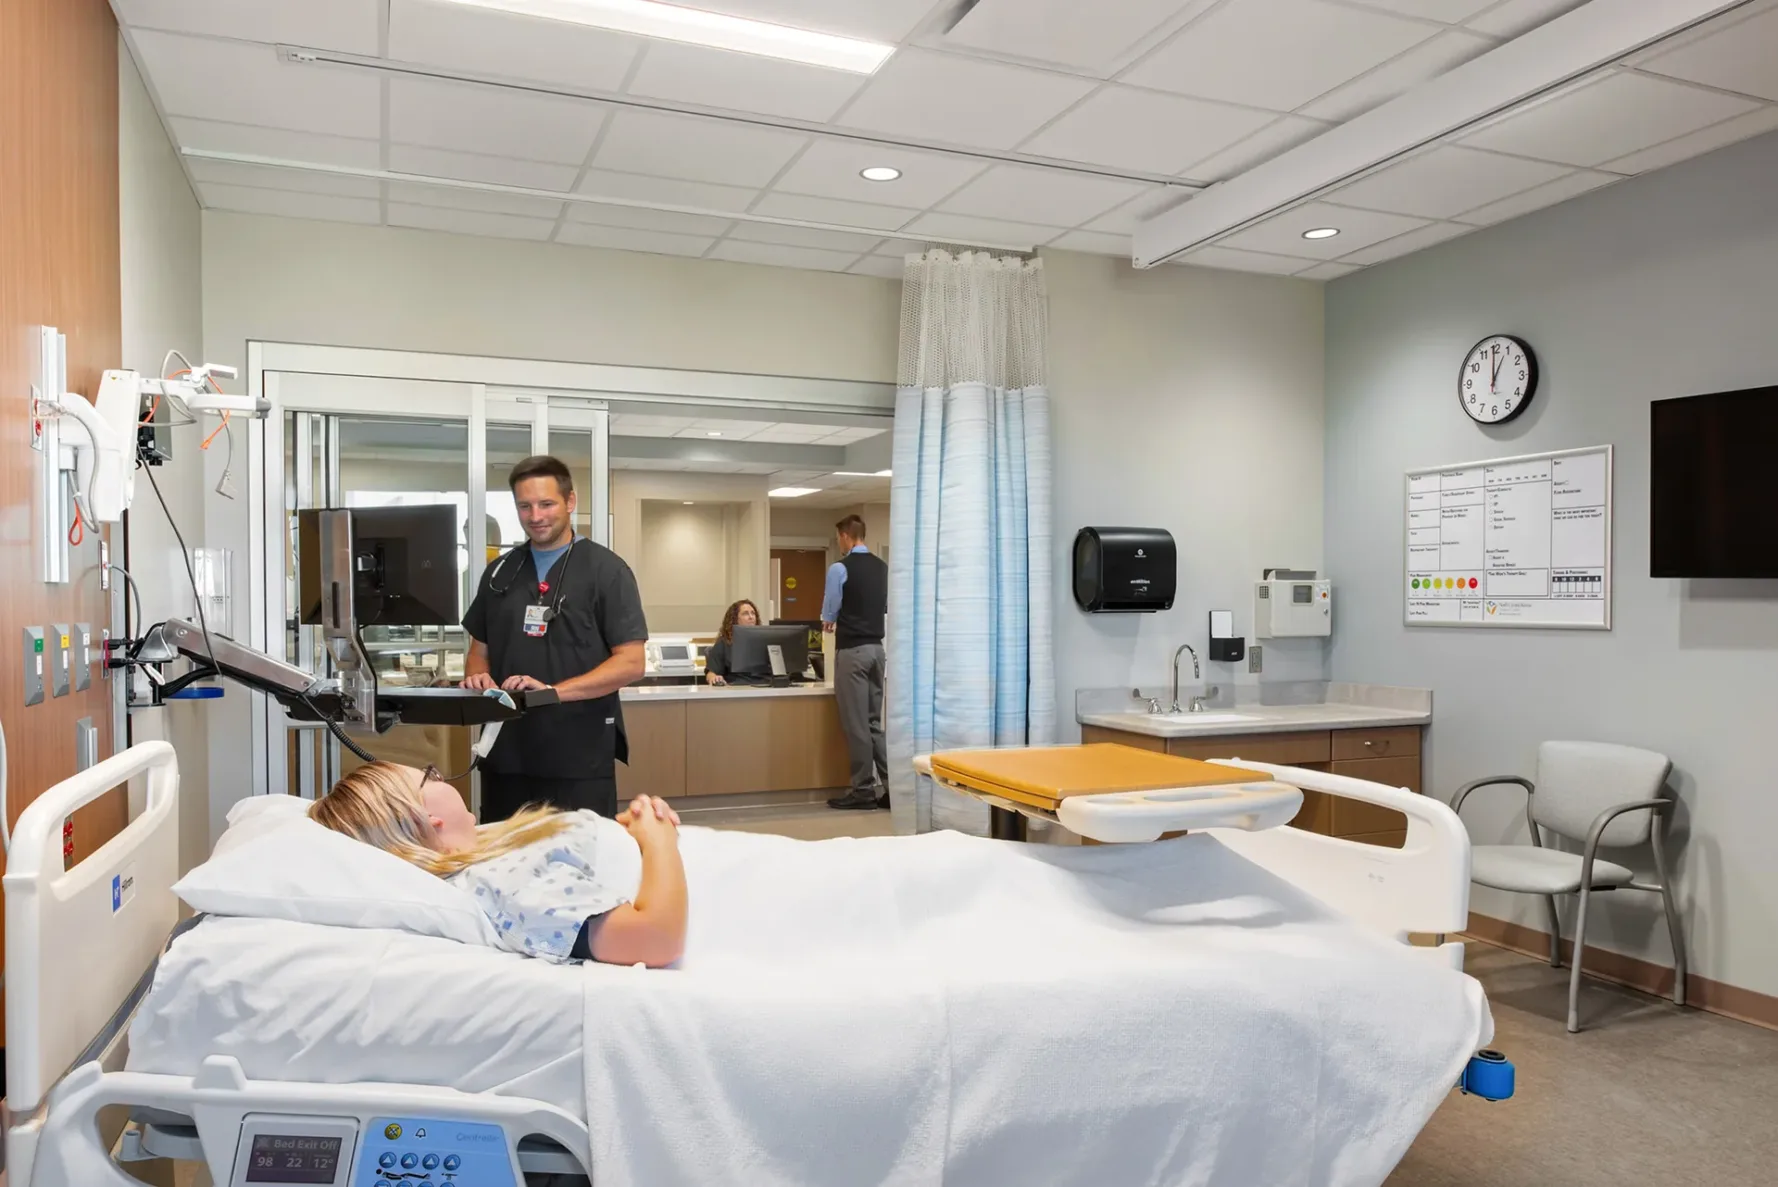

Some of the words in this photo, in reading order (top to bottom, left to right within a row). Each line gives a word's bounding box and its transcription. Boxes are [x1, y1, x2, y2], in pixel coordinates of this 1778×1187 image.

[1490, 344, 1501, 354] 12
[1505, 345, 1510, 355] 1
[1480, 350, 1488, 360] 11
[1514, 355, 1521, 366] 2
[1471, 362, 1480, 373] 10
[1518, 370, 1525, 381] 3
[1466, 379, 1472, 389] 9
[1514, 387, 1520, 397] 4
[1470, 393, 1476, 404] 8
[1480, 403, 1486, 413] 7
[1504, 399, 1511, 410] 5
[1491, 405, 1498, 416] 6
[274, 1139, 295, 1149] Bed
[297, 1140, 317, 1149] Exit
[320, 1140, 339, 1150] Off
[256, 1157, 273, 1167] 98
[286, 1157, 302, 1168] 22
